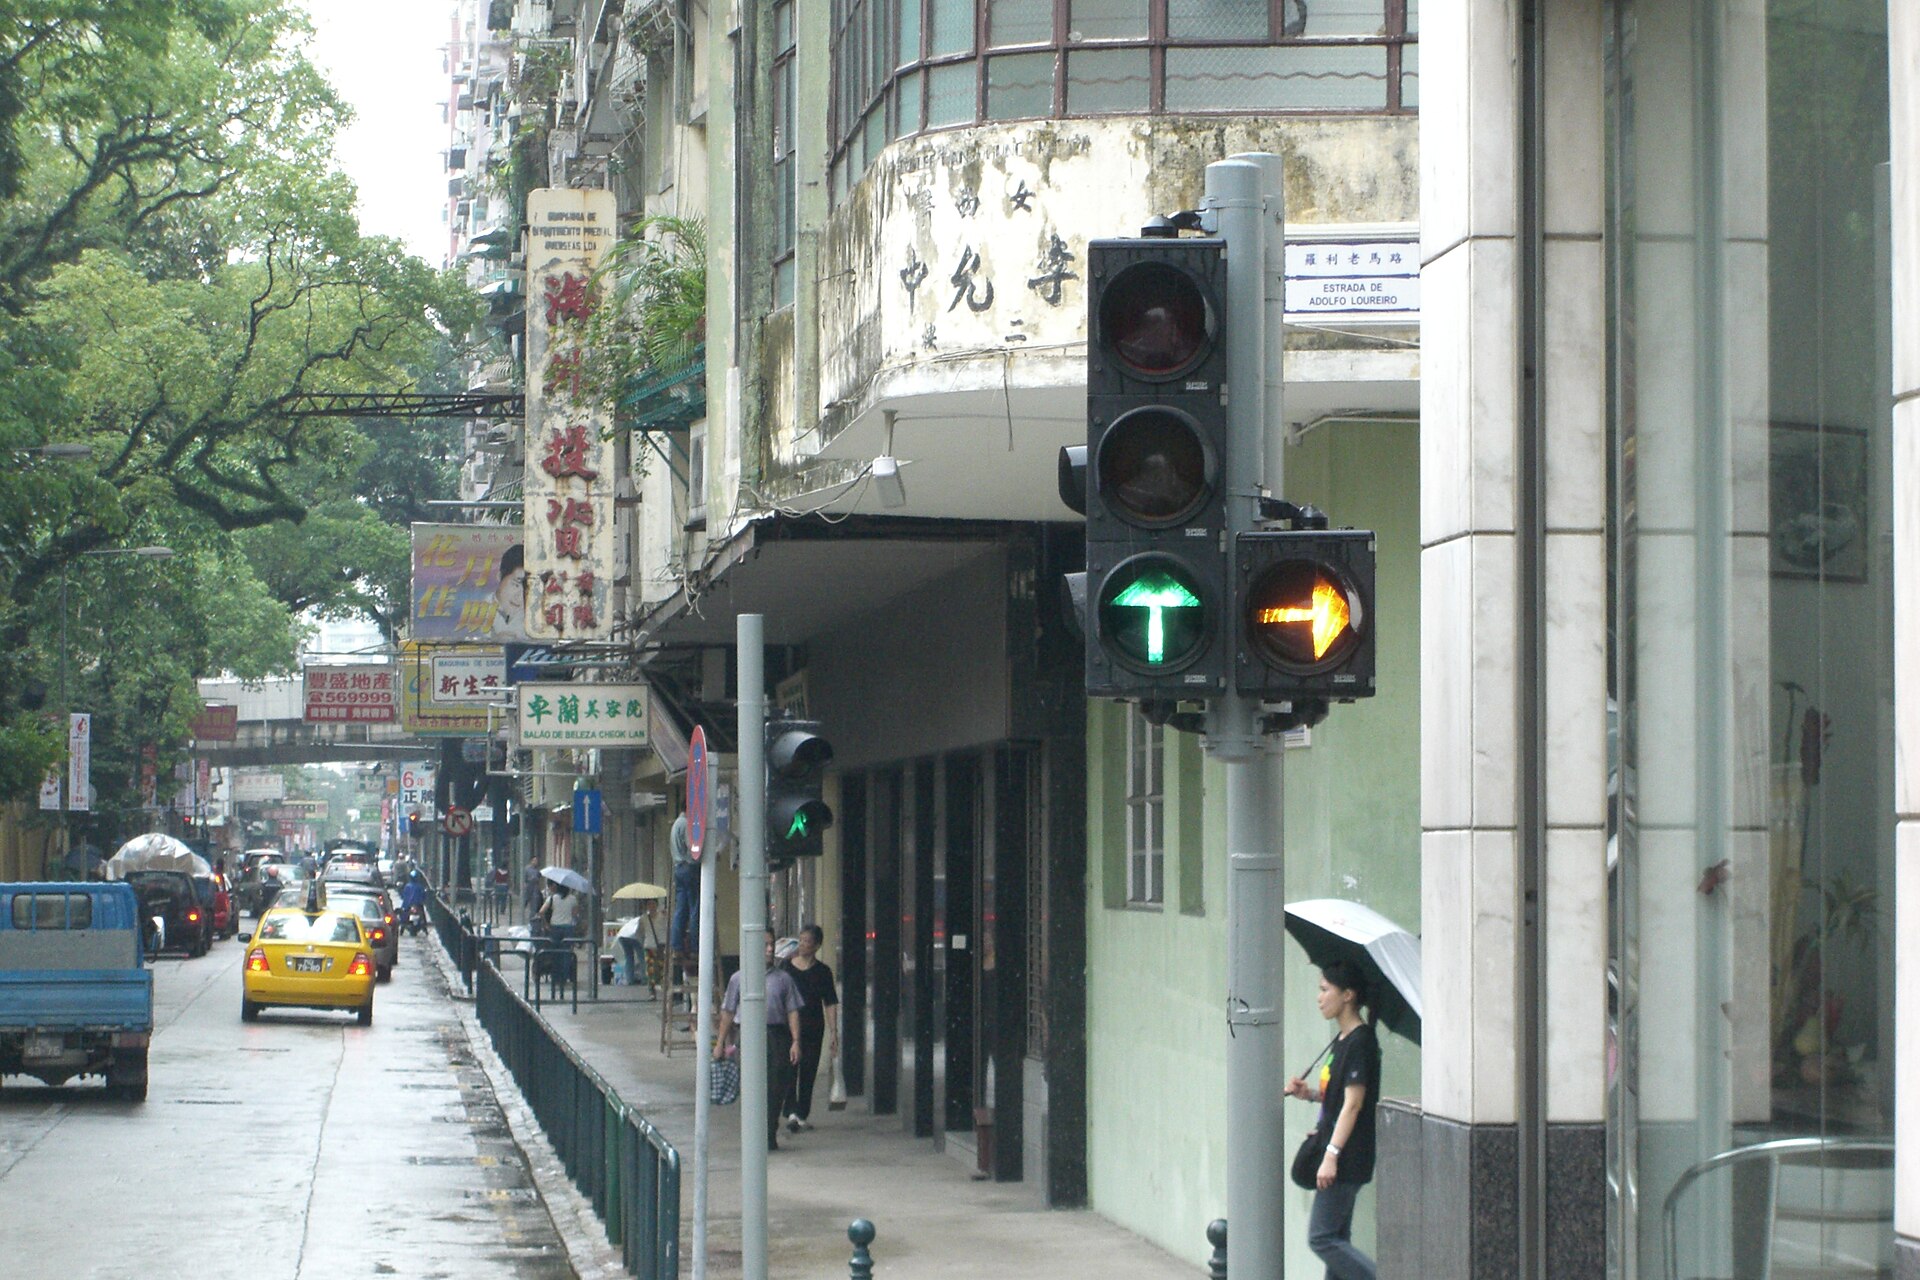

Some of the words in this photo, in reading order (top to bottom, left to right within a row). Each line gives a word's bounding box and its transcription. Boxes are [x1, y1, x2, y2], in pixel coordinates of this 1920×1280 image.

[1305, 252, 1402, 266] 羅利老馬路
[1323, 283, 1366, 293] ESTRADA
[1370, 283, 1383, 292] DE
[1309, 296, 1347, 306] ADOLFO
[1351, 296, 1398, 305] LOUREIRO
[552, 731, 563, 739] DE
[565, 731, 597, 739] BELEZA
[599, 730, 626, 739] CHEOK
